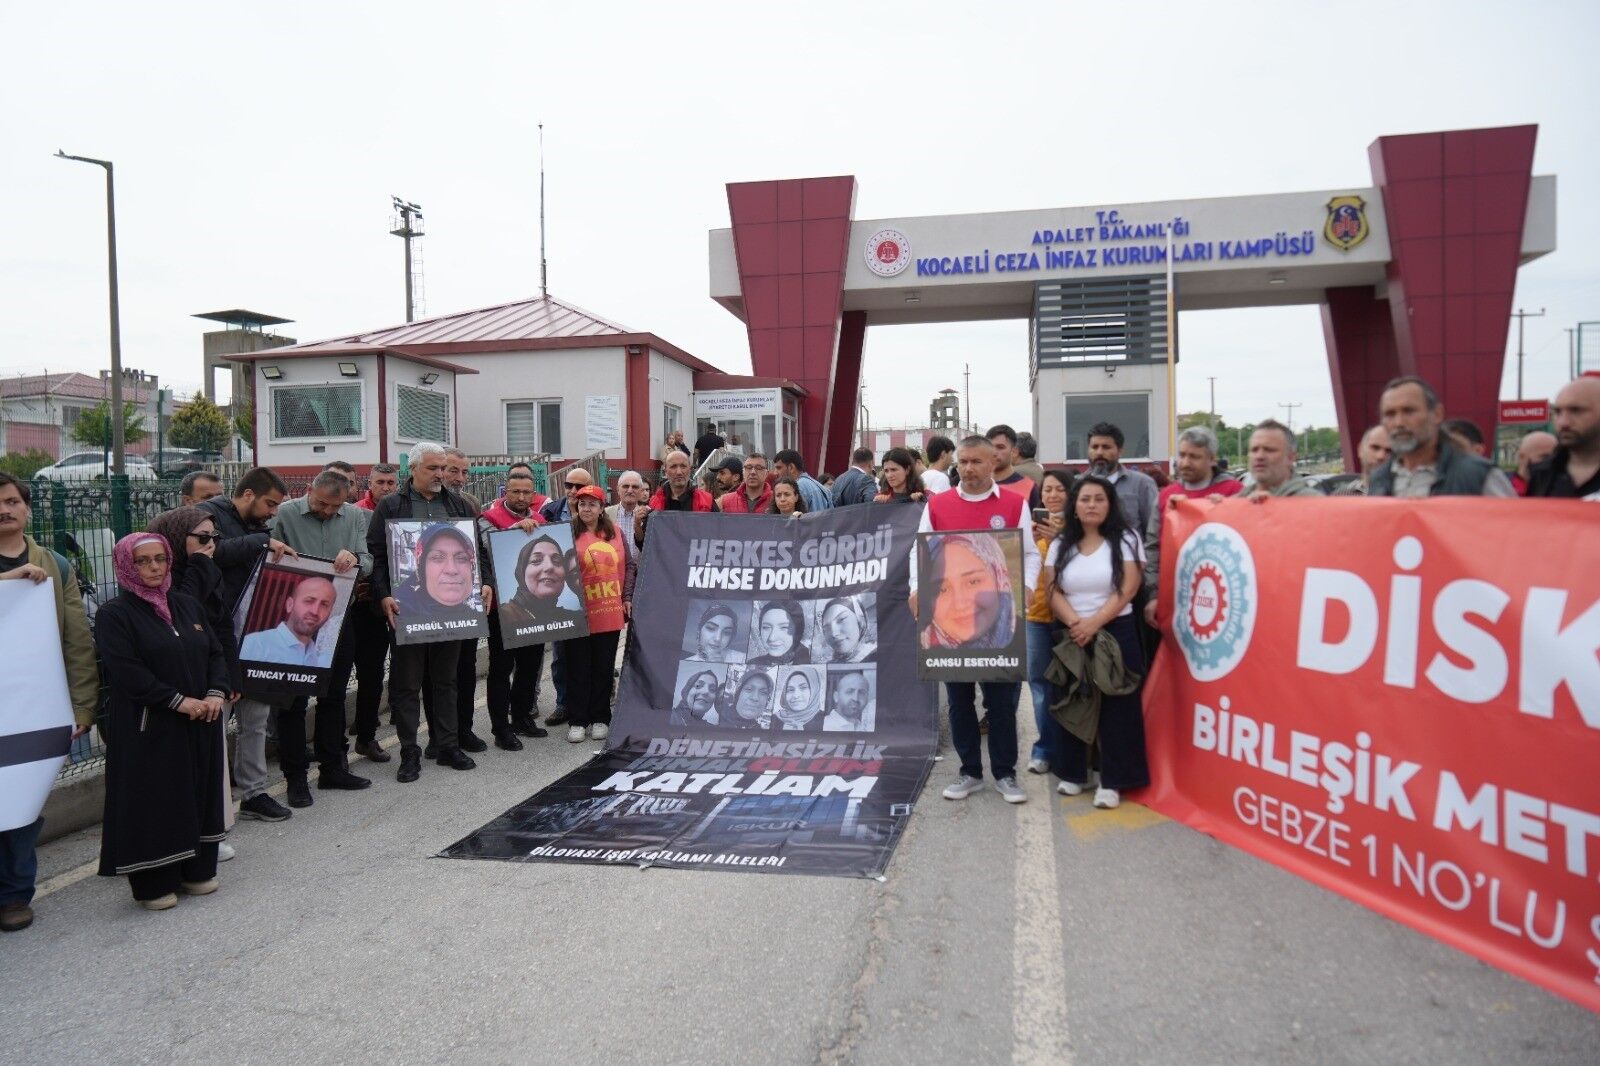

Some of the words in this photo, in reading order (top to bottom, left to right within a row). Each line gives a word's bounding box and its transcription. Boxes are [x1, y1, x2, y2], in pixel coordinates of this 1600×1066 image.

[1032, 227, 1095, 245] ADALET
[1100, 217, 1189, 240] BAKANLĞI
[1096, 210, 1123, 224] T.C.
[916, 249, 989, 277] KOCAELİ
[995, 252, 1040, 272] CEZA
[1045, 246, 1097, 270] İNFAZ
[1103, 241, 1212, 266] KURUMLARI
[1219, 231, 1315, 260] KAMPÜSÜ
[687, 538, 793, 568] HERKES
[799, 523, 893, 567] GÖRDÜ
[687, 563, 754, 590] KİMSE
[759, 557, 888, 590] DOKUNMADI
[406, 620, 443, 634] ŞENGÜL
[444, 619, 478, 629] YILMAZ
[516, 626, 545, 636] HANIM
[546, 620, 575, 631] GÜLEK
[1296, 535, 1600, 730] DİSK
[925, 657, 961, 667] CANSU
[963, 654, 1019, 667] ESETOĞLU
[247, 669, 285, 680] TUNCAY
[286, 672, 318, 683] YILDIZ
[645, 736, 888, 760] DENETİMSİZLİK
[591, 769, 879, 798] KATLİAM
[1192, 695, 1422, 821] BİRLEŞİK
[1432, 769, 1600, 884] MET
[1233, 786, 1352, 867] GEBZE
[1361, 834, 1378, 877] 1
[1392, 843, 1566, 949] NO'LU
